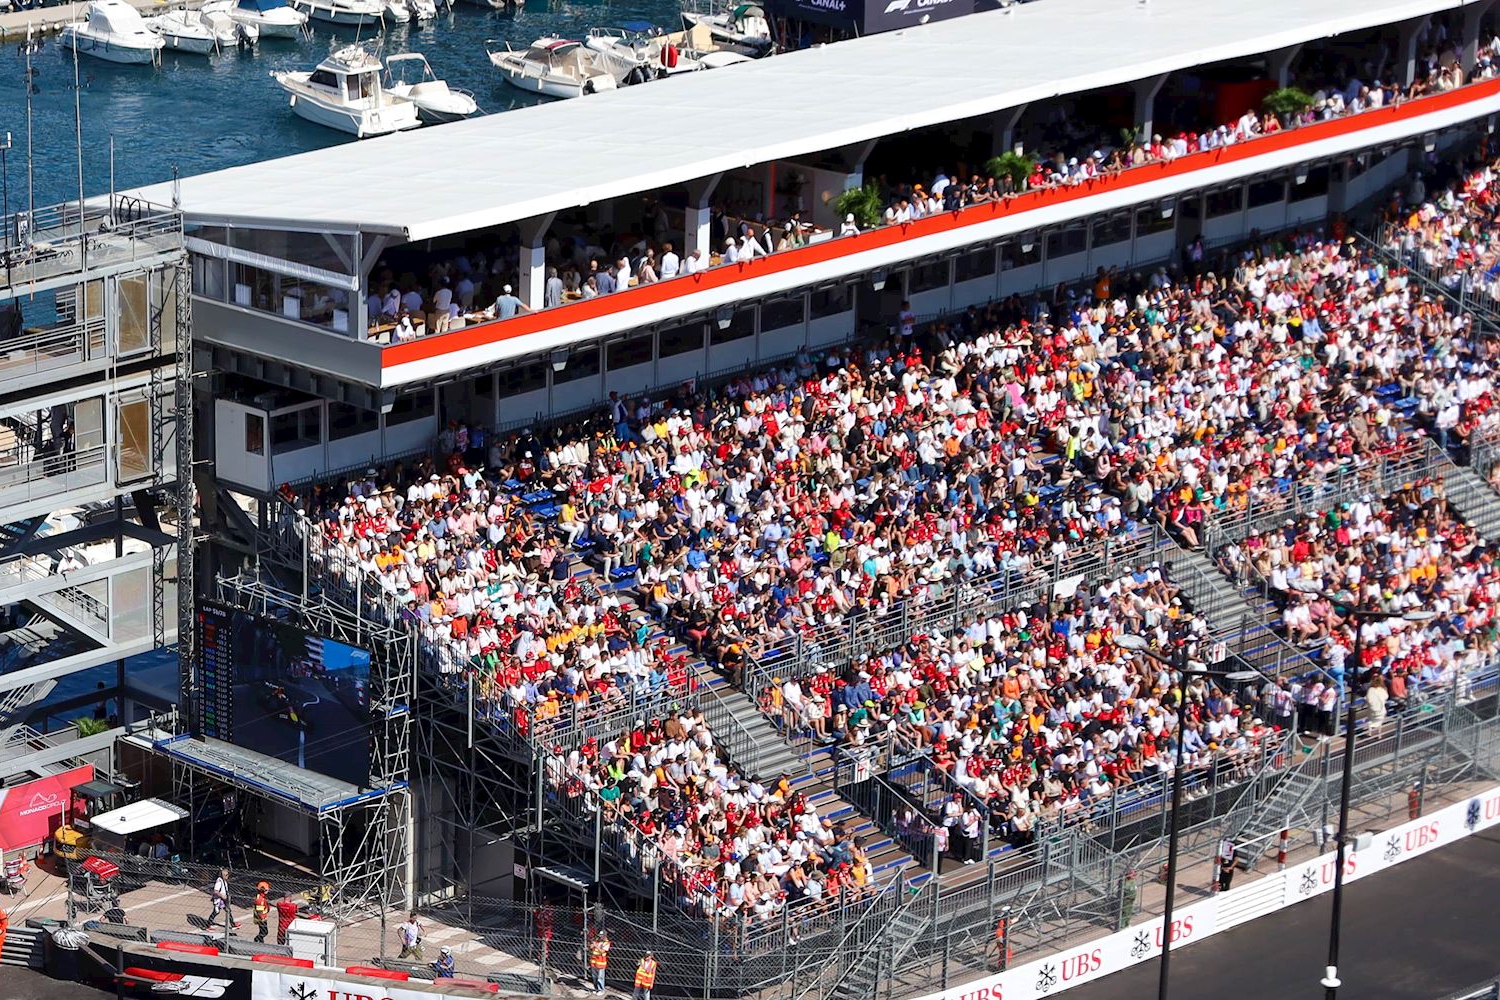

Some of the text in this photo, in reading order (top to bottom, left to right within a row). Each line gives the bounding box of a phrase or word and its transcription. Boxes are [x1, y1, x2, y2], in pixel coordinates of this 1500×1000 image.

[1405, 821, 1440, 851] UBS
[1321, 852, 1357, 884] US
[1061, 948, 1102, 982] UBS
